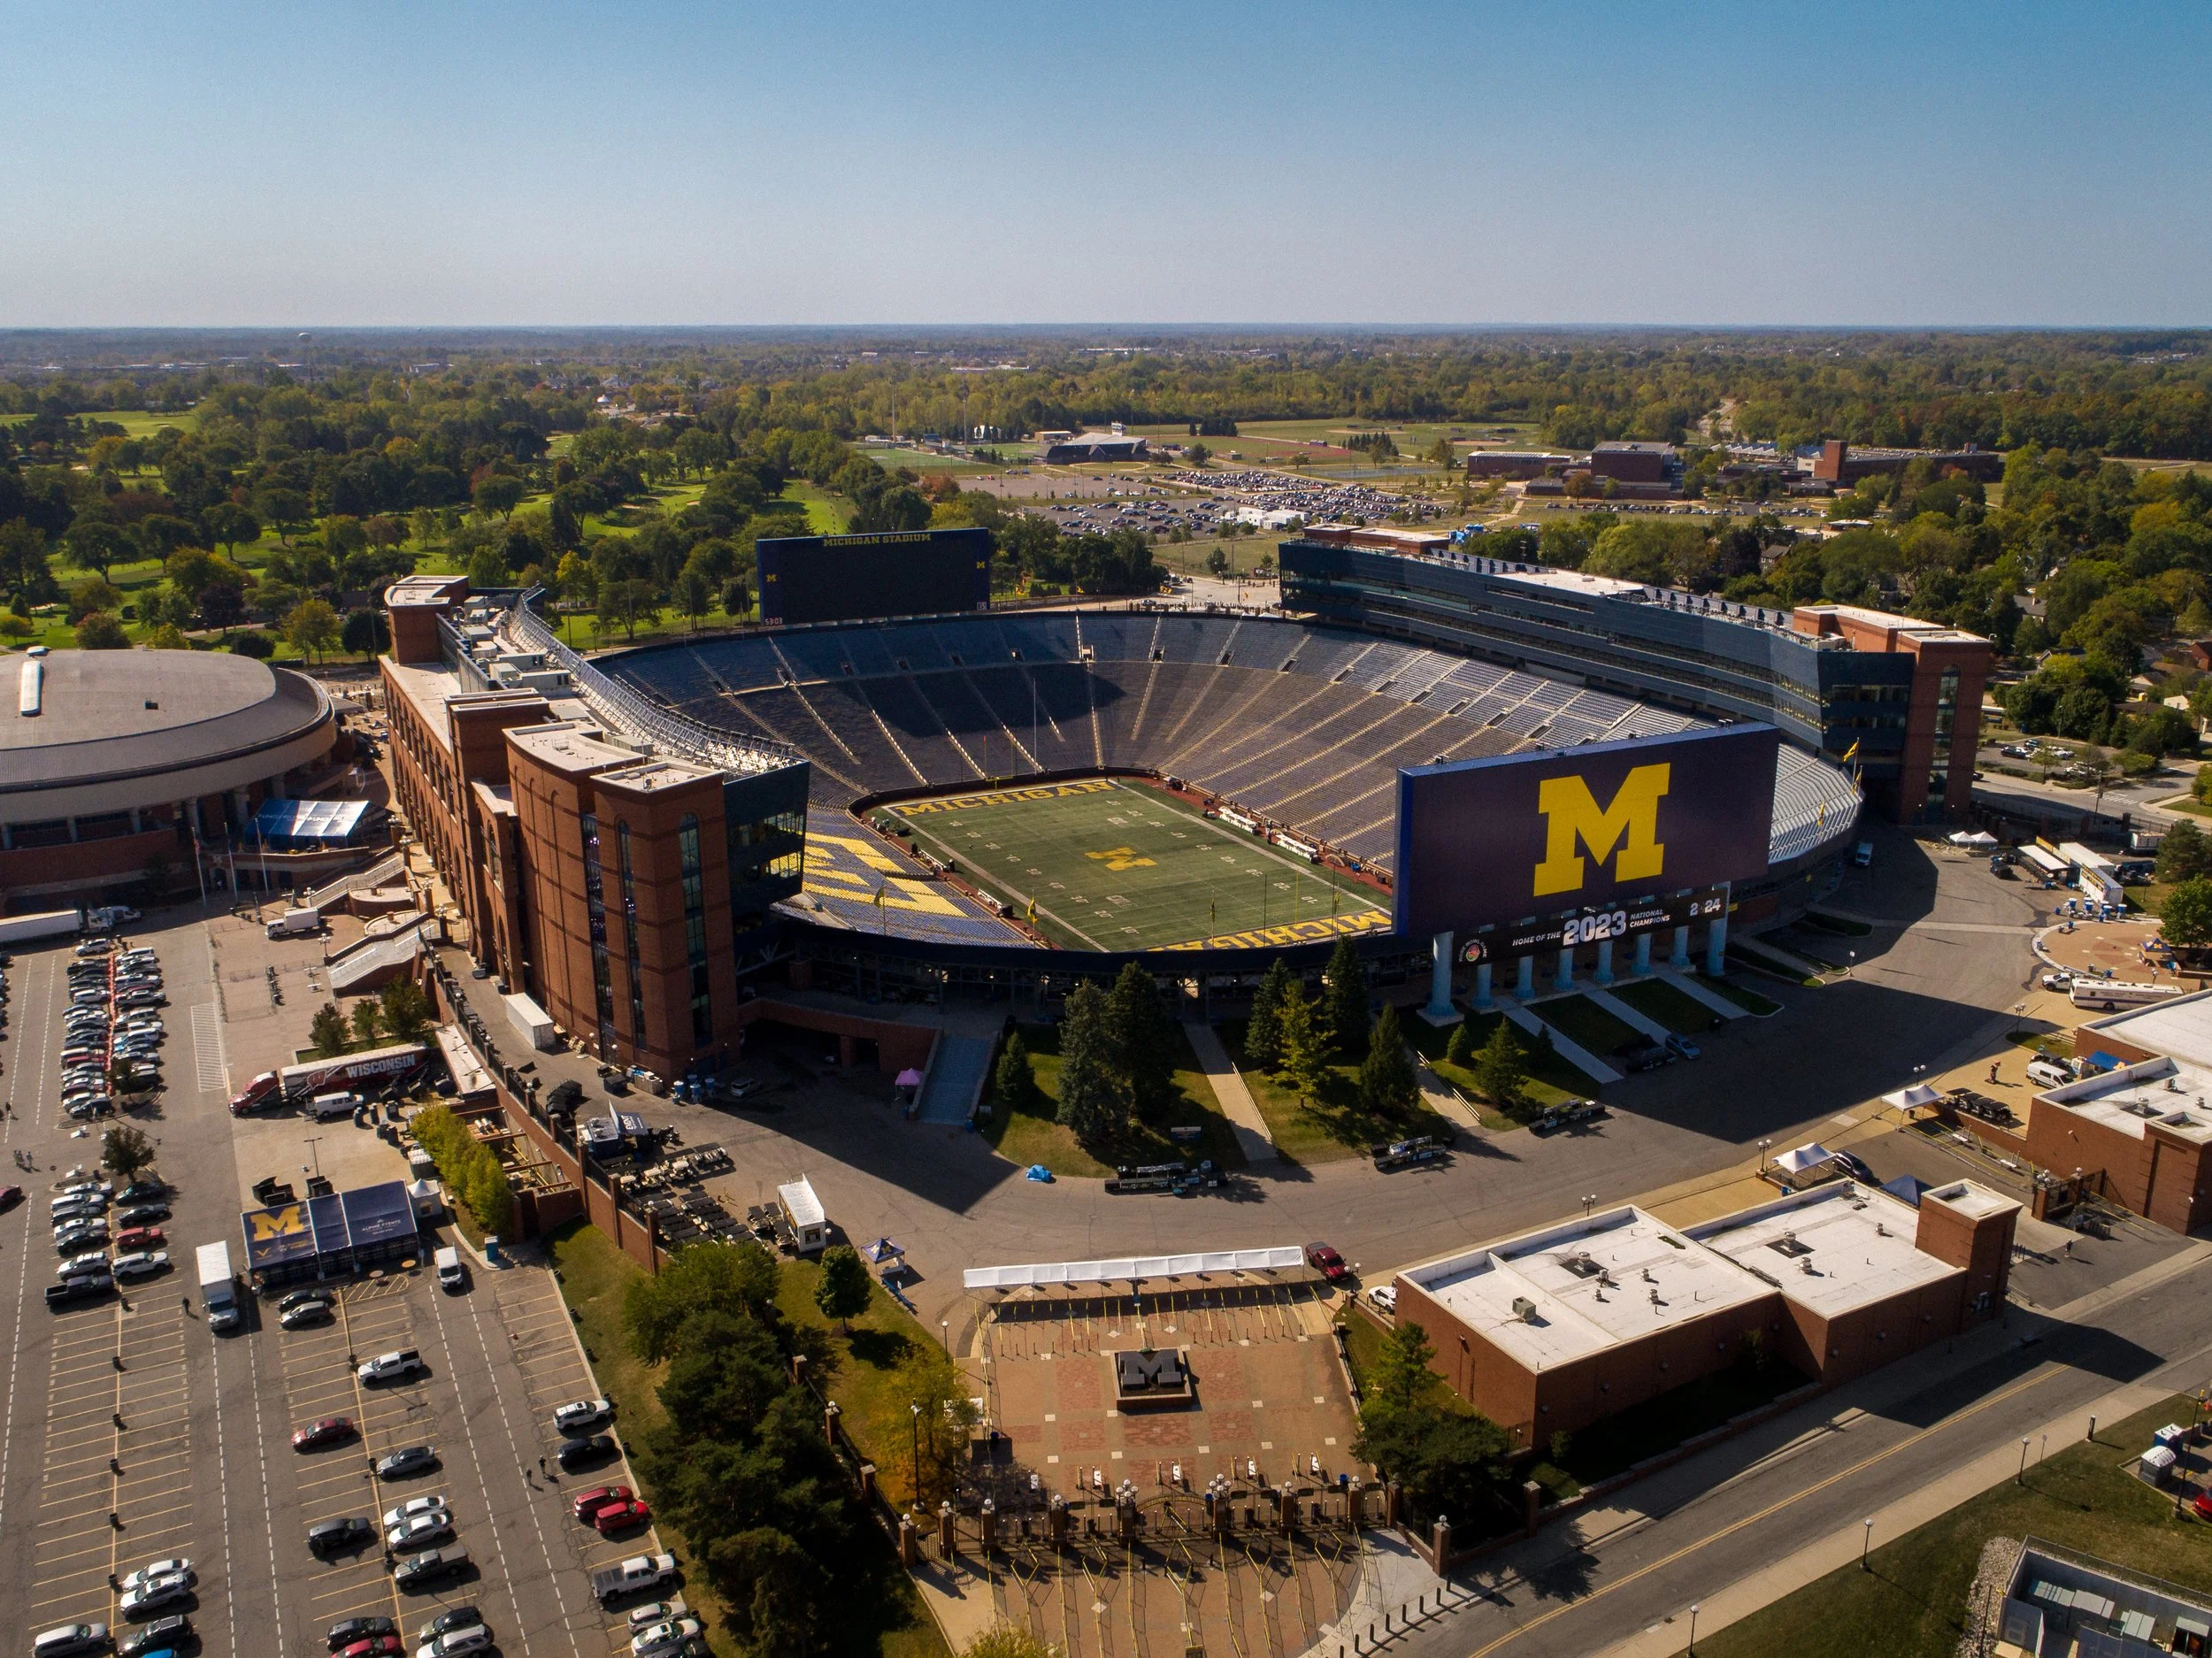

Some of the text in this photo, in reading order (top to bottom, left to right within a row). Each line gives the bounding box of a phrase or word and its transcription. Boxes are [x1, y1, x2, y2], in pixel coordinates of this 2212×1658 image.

[824, 533, 932, 547] MICHIGAN STADIUM
[895, 780, 1116, 816] MICHIGAN
[1533, 762, 1671, 897] M
[1630, 909, 1663, 920] NATIONAL
[1630, 914, 1671, 928] CHAMPIONS
[1512, 936, 1534, 947] HOME
[1547, 931, 1562, 940] THE
[1563, 910, 1626, 946] 2023
[1465, 939, 1480, 948] BOWL
[346, 1055, 416, 1078] WISCONSIN
[250, 1204, 304, 1242] M
[1119, 1348, 1182, 1390] M
